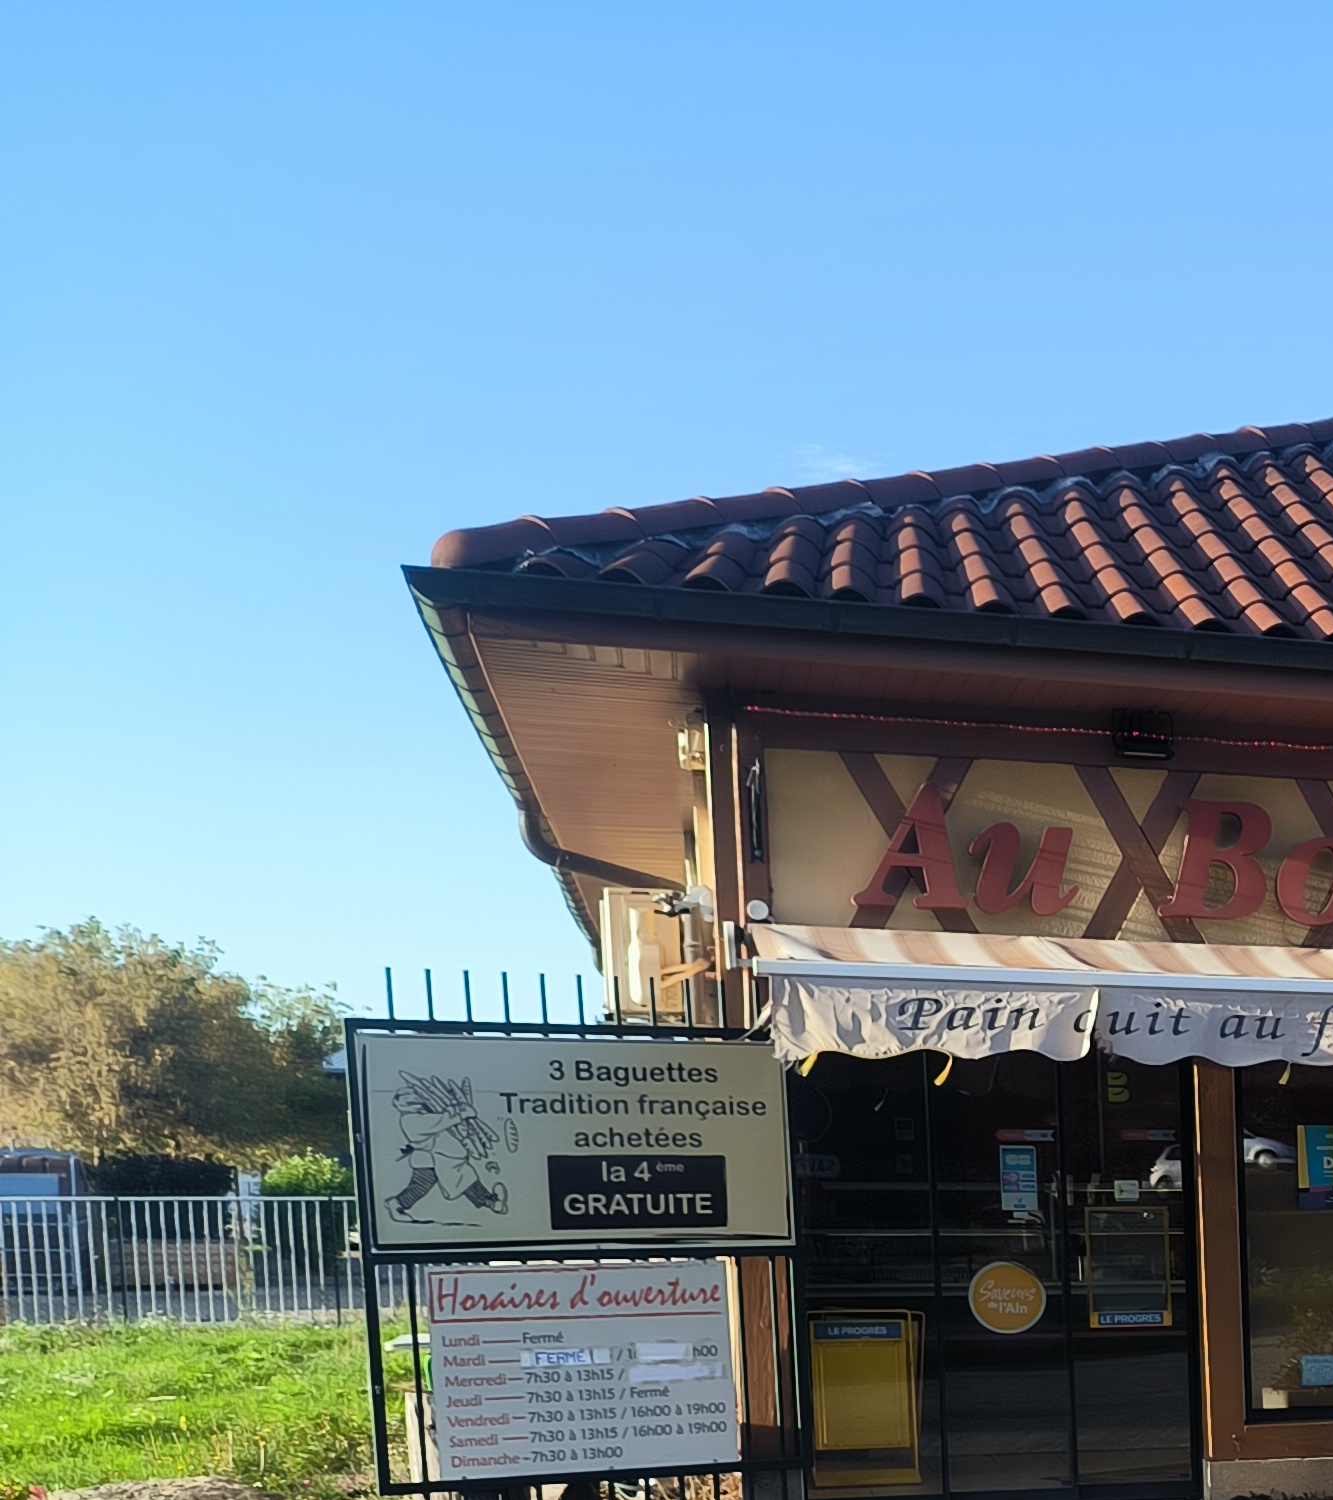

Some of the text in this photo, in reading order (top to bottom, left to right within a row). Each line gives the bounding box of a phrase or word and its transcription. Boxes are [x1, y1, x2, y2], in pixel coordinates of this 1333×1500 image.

[851, 781, 1080, 917] Au
[899, 998, 1046, 1033] Pain
[1074, 1002, 1191, 1036] cuit
[1220, 1014, 1286, 1040] au
[549, 1060, 718, 1087] 3 Baguettes
[501, 1092, 766, 1121] Tradition française
[574, 1128, 703, 1149] achetées
[602, 1160, 627, 1182] la
[633, 1161, 652, 1182] 4
[564, 1194, 713, 1215] GRATUITE
[438, 1274, 721, 1315] Horaires d'ouverture
[979, 1280, 1037, 1303] Saveurs
[999, 1302, 1028, 1314] l'Ain
[1101, 1314, 1113, 1324] LE
[442, 1331, 564, 1347] Lundi Fermé
[828, 1326, 839, 1335] LE
[444, 1354, 486, 1367] Mardi
[445, 1373, 507, 1387] Mercredi
[525, 1371, 560, 1384] 7h30
[565, 1370, 572, 1382] à
[577, 1369, 614, 1381] 13h15
[446, 1394, 482, 1408] Jeudi
[526, 1391, 562, 1404] 7h30
[566, 1390, 574, 1402] à
[579, 1388, 615, 1401] 13h15
[630, 1386, 670, 1398] Fermé
[447, 1413, 510, 1428] Vendredi
[528, 1411, 563, 1424] 7h30
[567, 1410, 575, 1421] à
[580, 1408, 616, 1420] 13h15
[632, 1405, 671, 1418] 16h00
[675, 1404, 683, 1415] à
[687, 1402, 726, 1415] 19h00
[449, 1433, 499, 1448] Samedi
[530, 1430, 565, 1444] 7h30
[569, 1429, 577, 1441] à
[581, 1427, 618, 1440] 13h15
[633, 1424, 672, 1437] 16h00
[676, 1423, 684, 1435] à
[688, 1421, 727, 1434] 19h00
[451, 1446, 623, 1468] Dimanche 7h30 à 13h00
